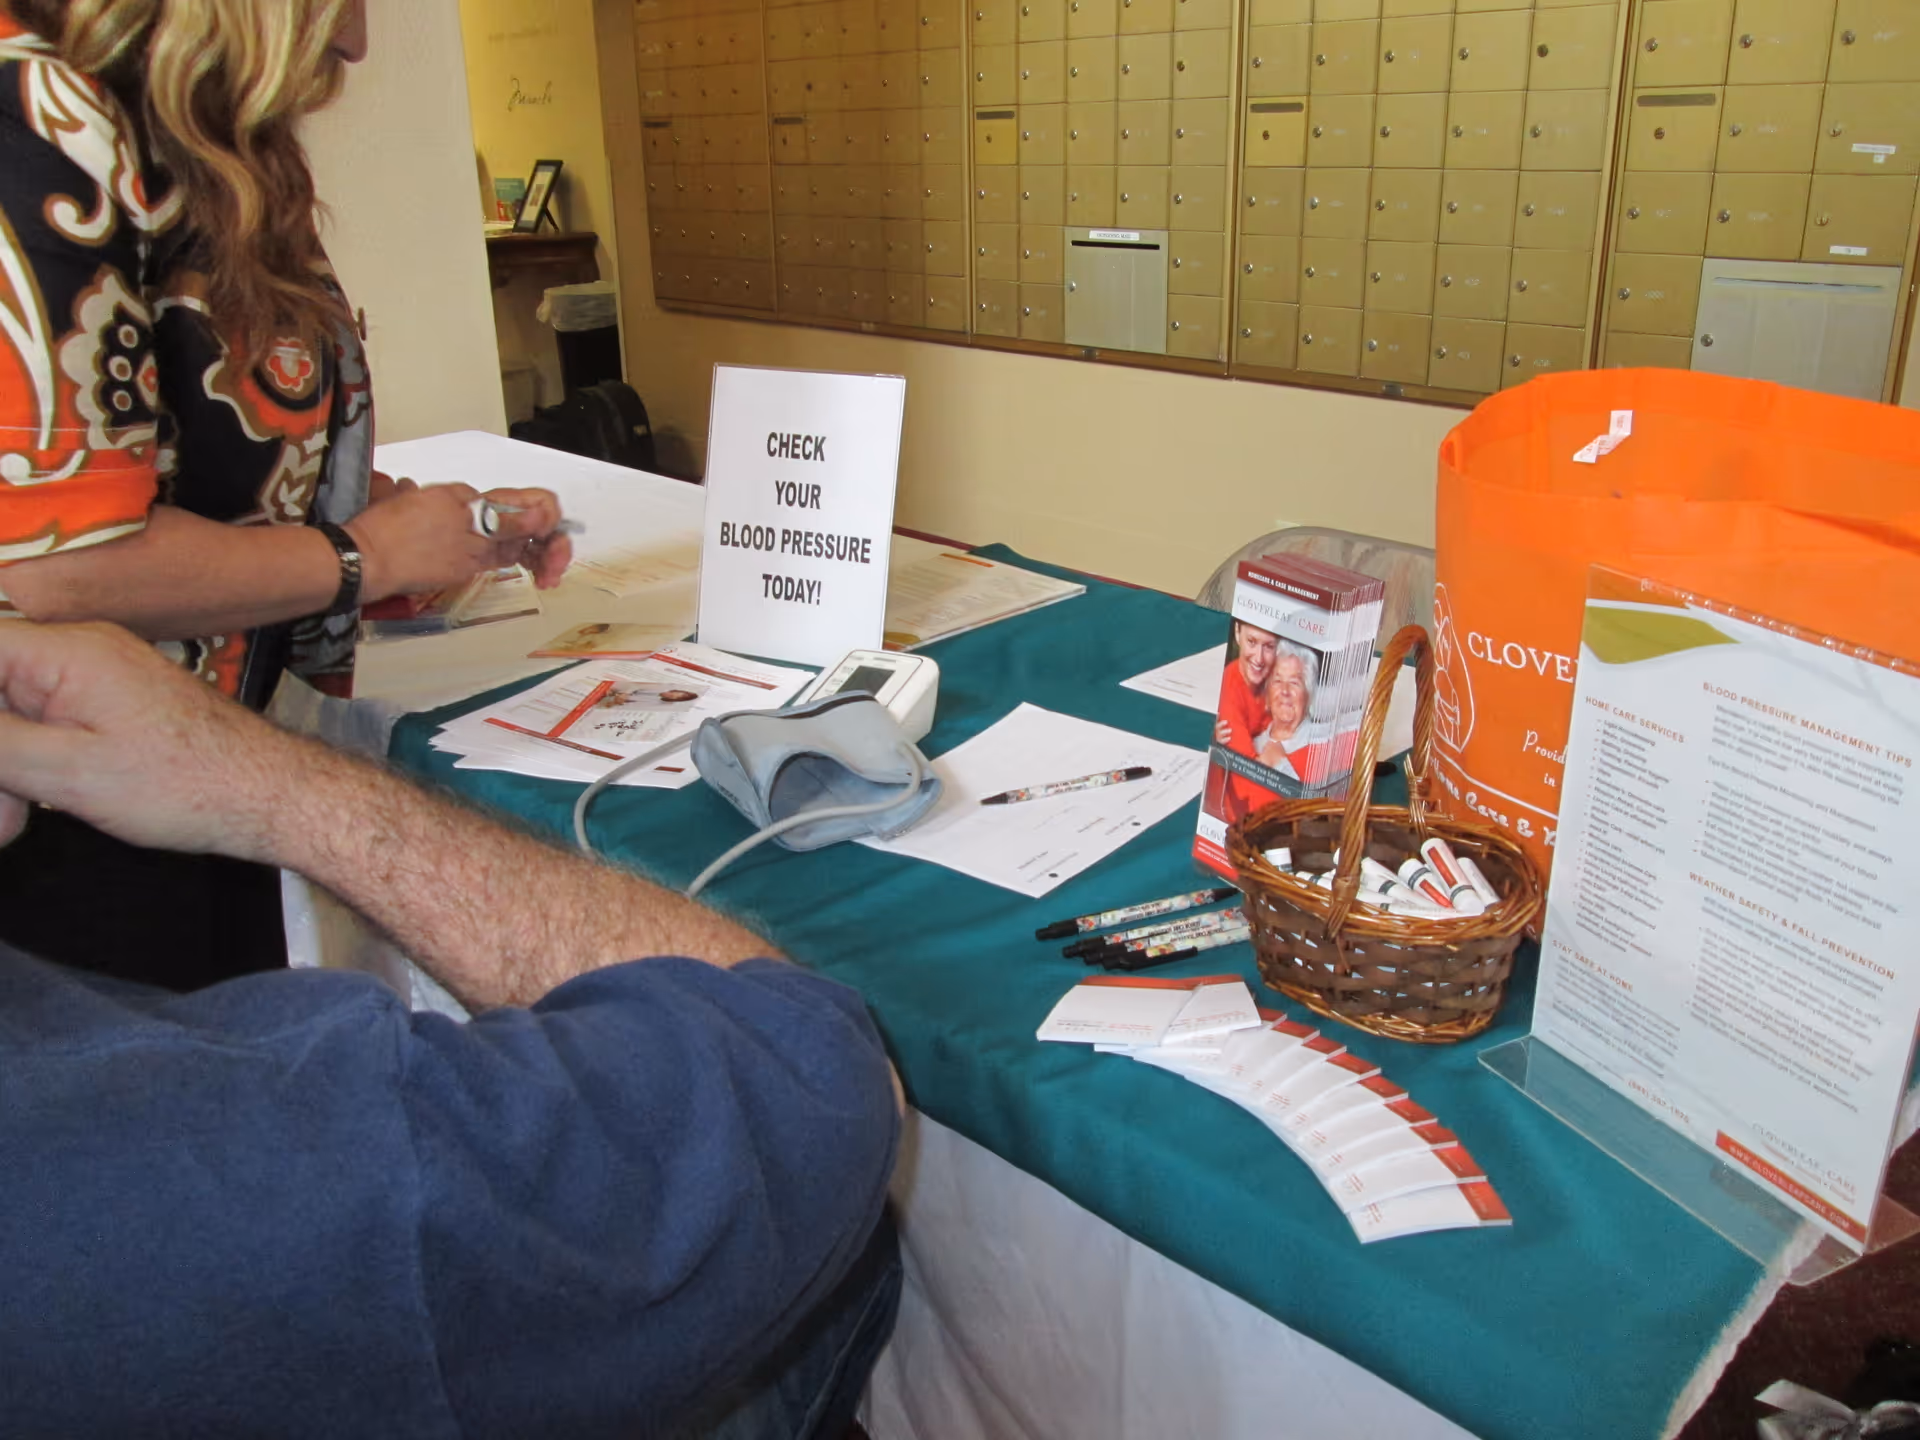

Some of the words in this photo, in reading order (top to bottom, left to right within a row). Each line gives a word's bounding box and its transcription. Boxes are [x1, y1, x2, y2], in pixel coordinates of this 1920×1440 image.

[767, 432, 826, 461] CHECK
[775, 480, 821, 509] YOUR
[720, 522, 775, 552] BLOOD
[781, 529, 871, 563] PRESSURE
[762, 574, 821, 605] TODAY!
[1275, 581, 1287, 590] CASE
[1287, 585, 1319, 600] MANAGEMENT
[1298, 618, 1325, 635] CARE
[1468, 632, 1578, 683] CLOVE
[1586, 696, 1609, 711] HOME
[1613, 707, 1636, 723] CARE
[1640, 718, 1684, 743] SERVICES
[1703, 682, 1738, 701] BLOOD
[1741, 696, 1796, 724] PRESSURE
[1800, 719, 1880, 756] MANAGEMENT
[1886, 749, 1912, 768] TIPS
[1543, 772, 1557, 788] in
[1465, 791, 1510, 828] Care
[1689, 871, 1735, 901] WEATHER
[1739, 896, 1778, 922] SAFETY
[1781, 917, 1788, 928] &
[1792, 922, 1817, 943] FALL
[1822, 937, 1895, 980] PREVENTION
[1552, 939, 1572, 955] STAY
[1575, 951, 1597, 970] SAFE
[1597, 966, 1607, 977] AT
[1609, 973, 1634, 993] HOME
[1826, 1169, 1856, 1196] CARE
